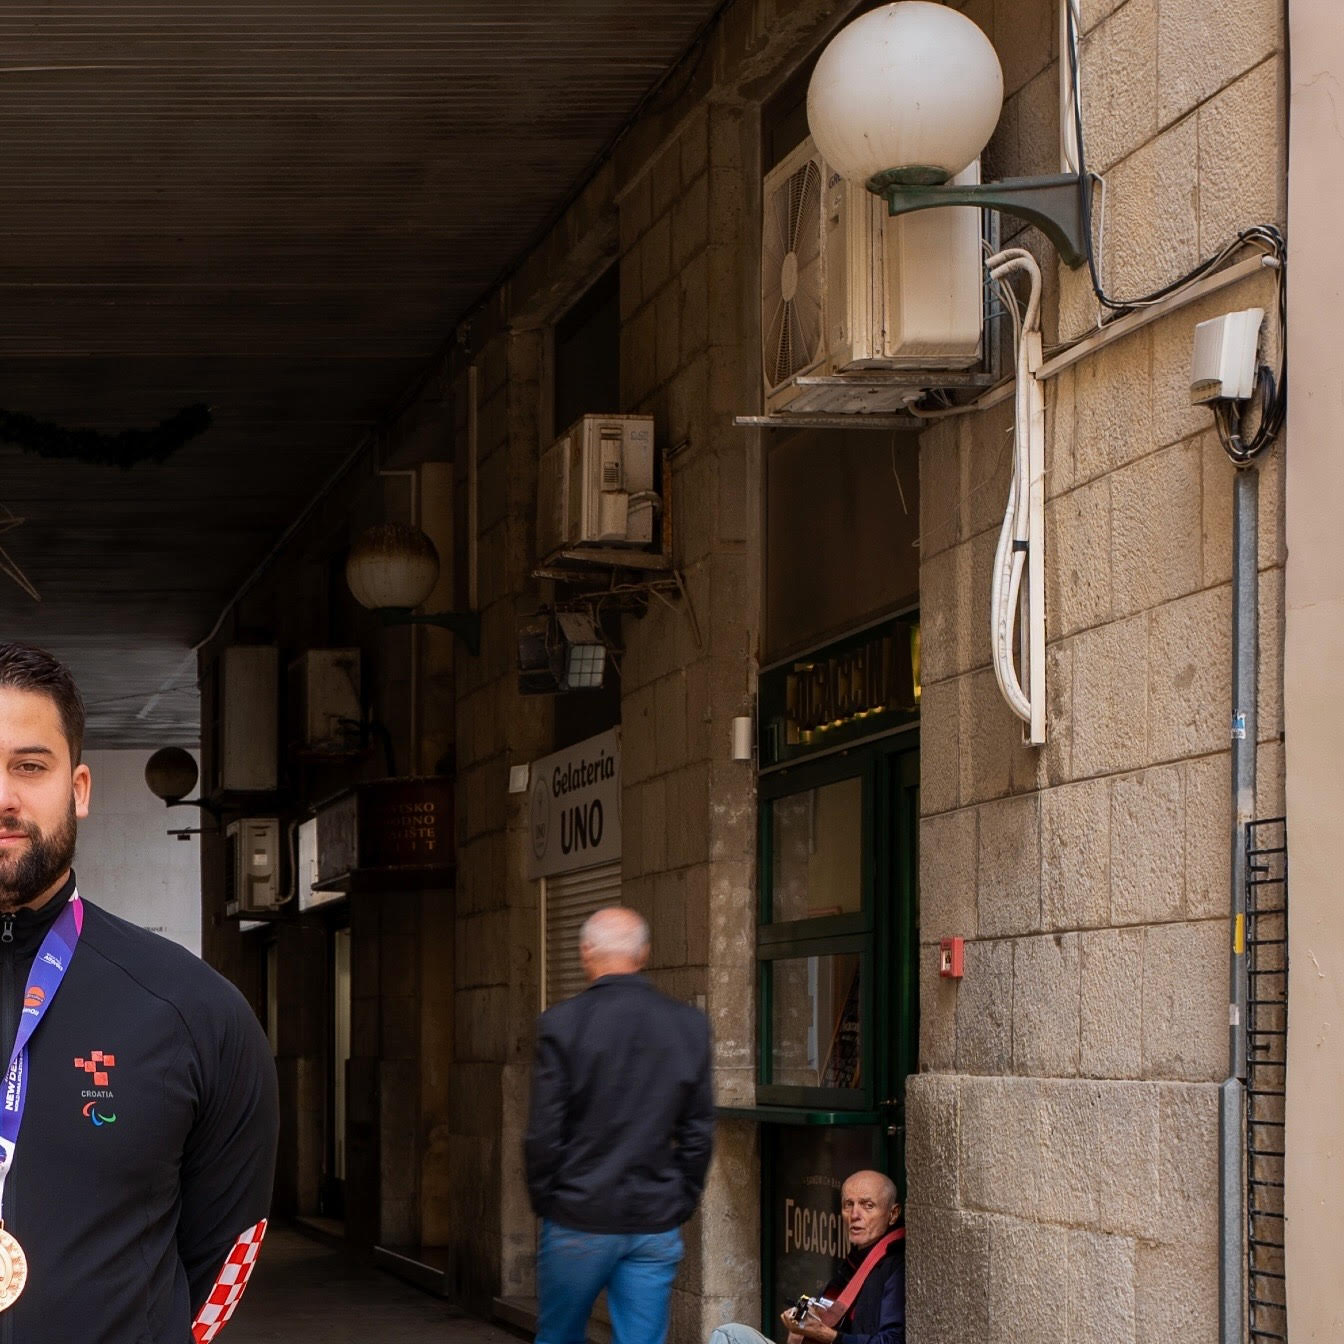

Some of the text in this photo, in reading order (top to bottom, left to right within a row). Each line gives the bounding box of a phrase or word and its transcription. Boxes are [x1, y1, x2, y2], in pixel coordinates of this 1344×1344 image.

[552, 749, 614, 798] Gelateria
[561, 799, 604, 855] UNO
[5, 1081, 16, 1111] NEW
[81, 1090, 114, 1098] CROATIA
